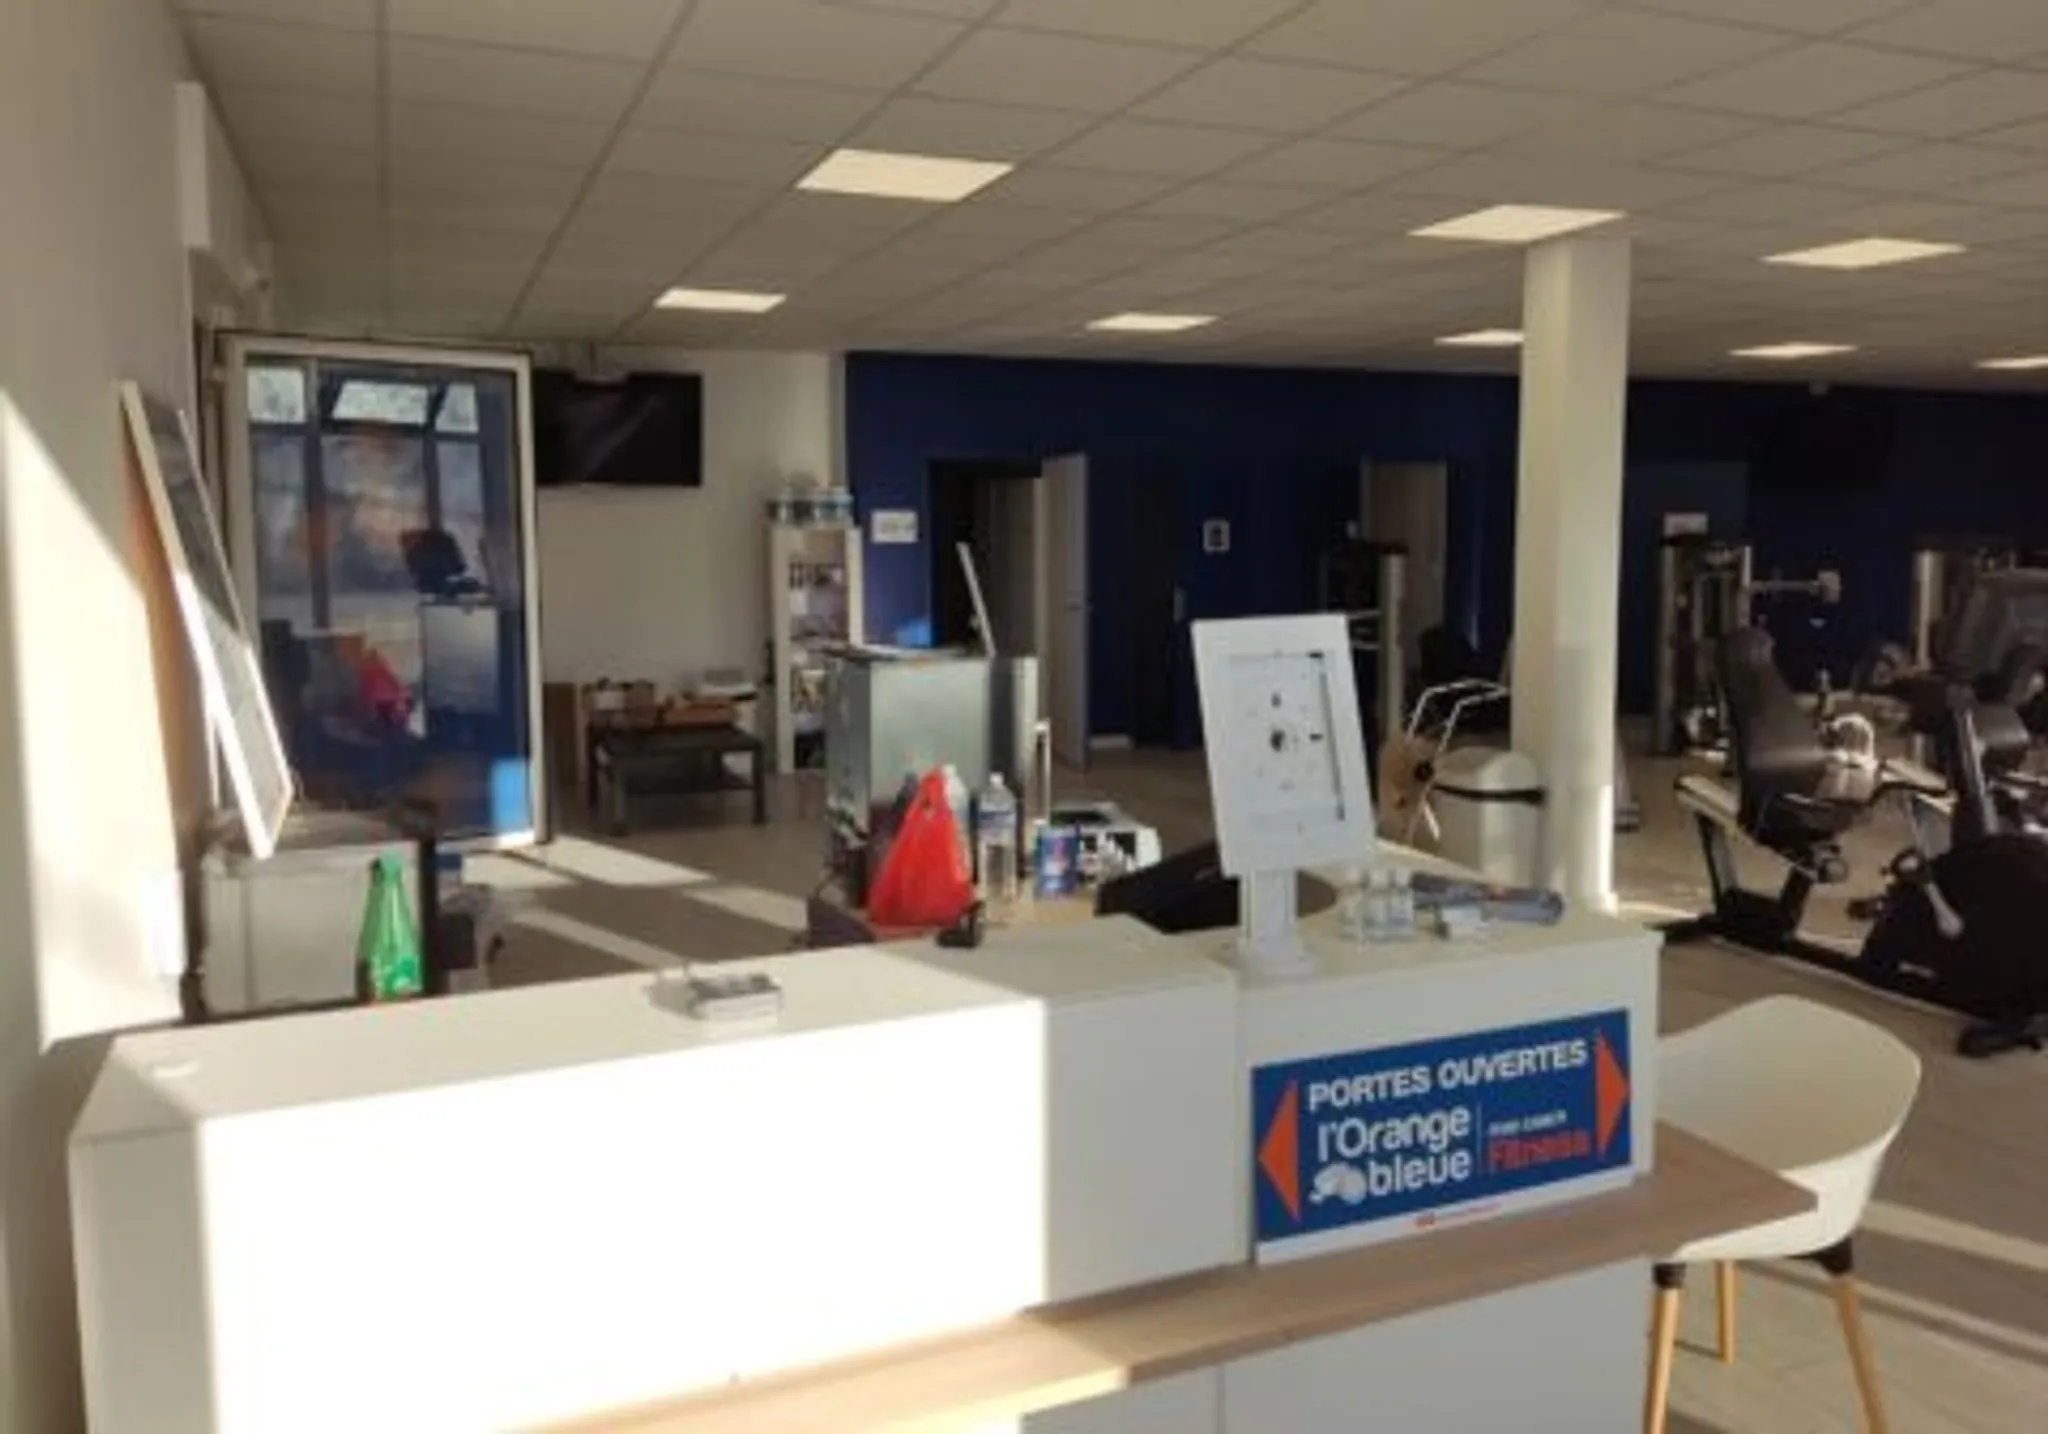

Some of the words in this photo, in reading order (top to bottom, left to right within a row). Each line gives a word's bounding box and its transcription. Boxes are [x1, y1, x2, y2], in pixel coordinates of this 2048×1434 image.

[1309, 1065, 1431, 1113] PORTES
[1437, 1039, 1588, 1090] OUVERTES
[1318, 1106, 1470, 1162] l'Orange
[1368, 1148, 1470, 1196] bleue
